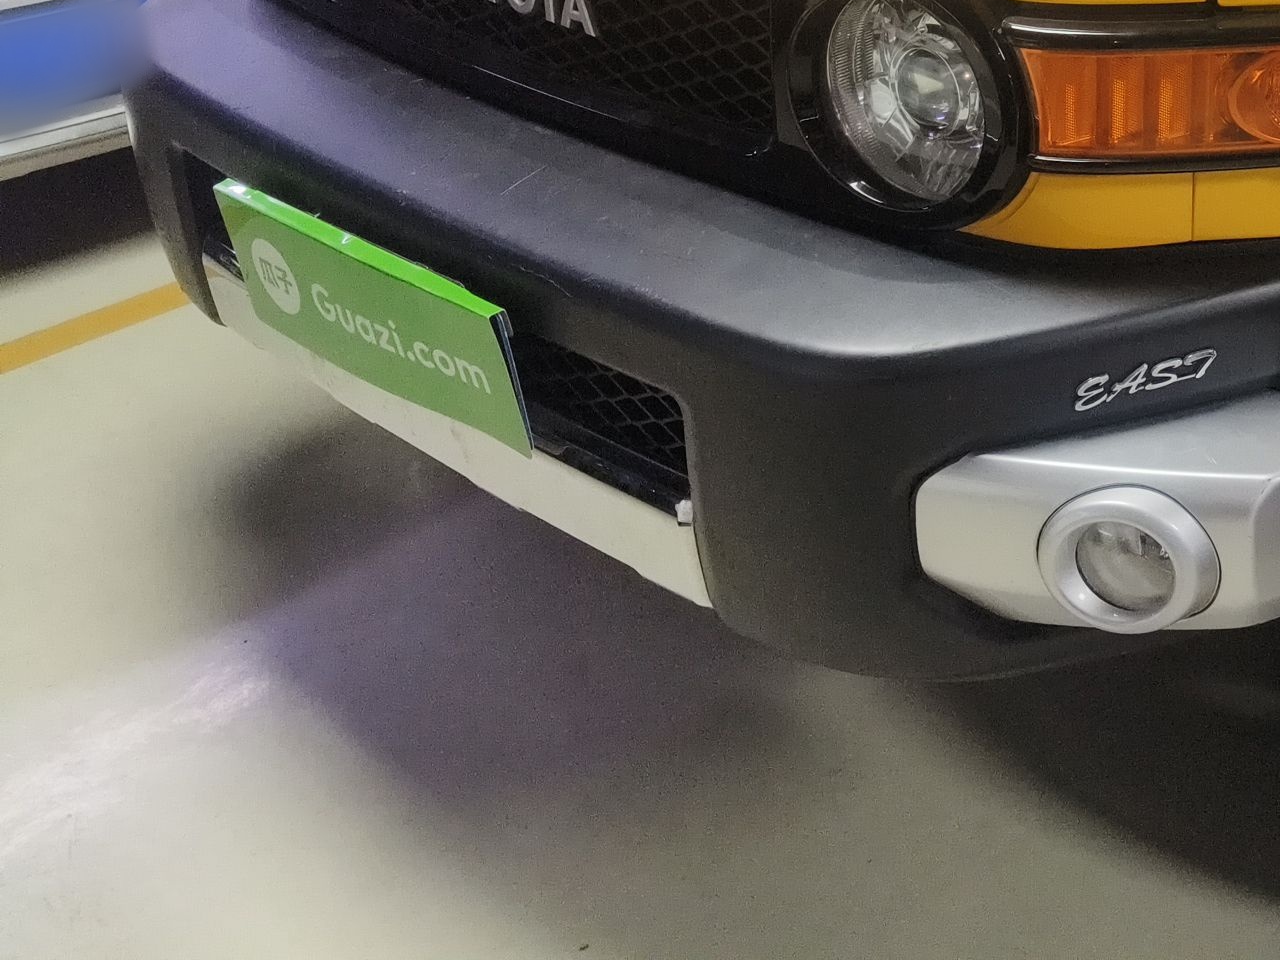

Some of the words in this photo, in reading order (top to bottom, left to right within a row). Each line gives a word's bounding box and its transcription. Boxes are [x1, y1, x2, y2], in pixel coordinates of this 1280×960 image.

[259, 256, 294, 295] 瓜子
[311, 283, 491, 394] Guazi.com
[1075, 348, 1217, 411] EAST
